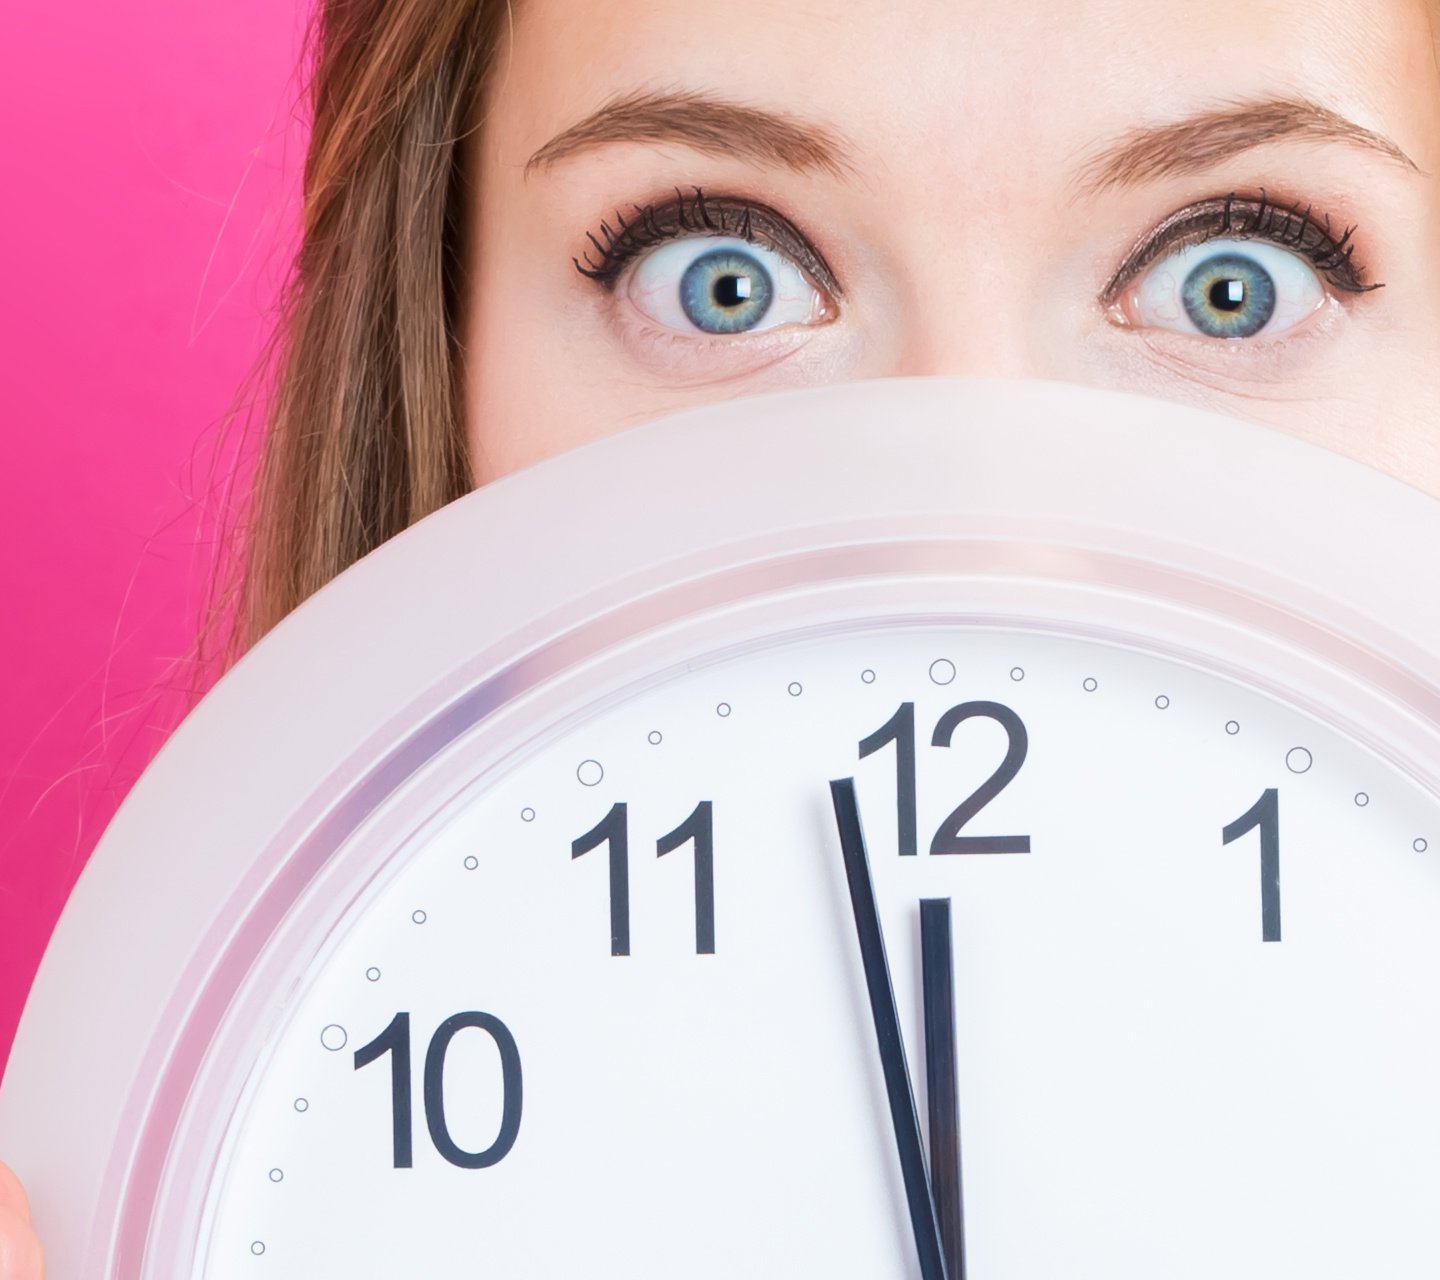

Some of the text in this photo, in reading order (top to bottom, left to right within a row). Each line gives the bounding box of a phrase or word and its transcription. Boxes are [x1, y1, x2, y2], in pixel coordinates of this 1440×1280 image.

[859, 701, 1030, 856] 12
[572, 801, 715, 956] 11
[1223, 789, 1281, 941] 1
[354, 1012, 522, 1169] 10
